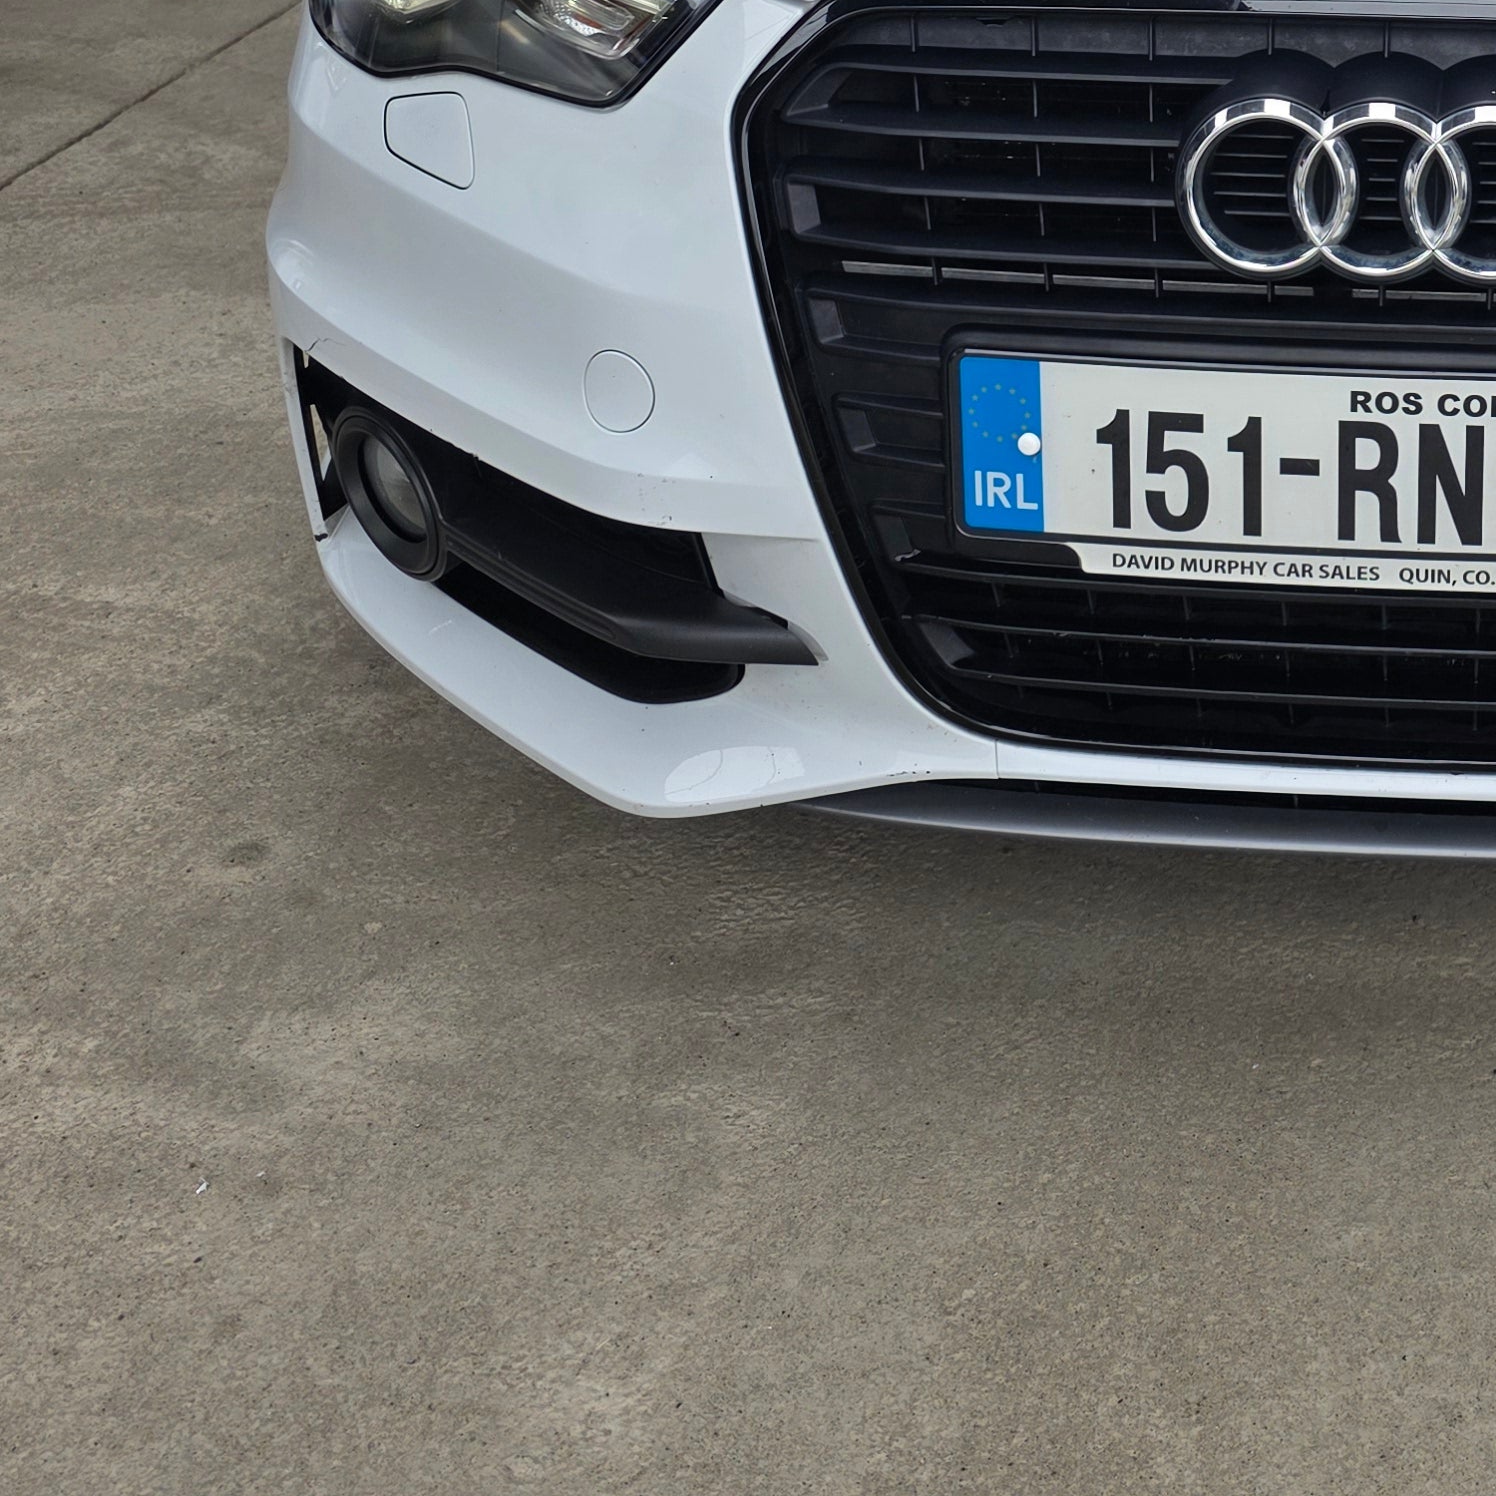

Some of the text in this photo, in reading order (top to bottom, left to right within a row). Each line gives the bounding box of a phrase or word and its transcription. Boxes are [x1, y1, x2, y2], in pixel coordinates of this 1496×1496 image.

[1350, 390, 1423, 416] ROS
[974, 470, 1038, 510] IRL
[1112, 553, 1175, 571] DAVID
[1180, 557, 1267, 576] MURPHY
[1273, 562, 1313, 578] CAR
[1319, 564, 1380, 581] SALES
[1399, 567, 1457, 586] QUIN,
[1462, 570, 1496, 585] CO.
